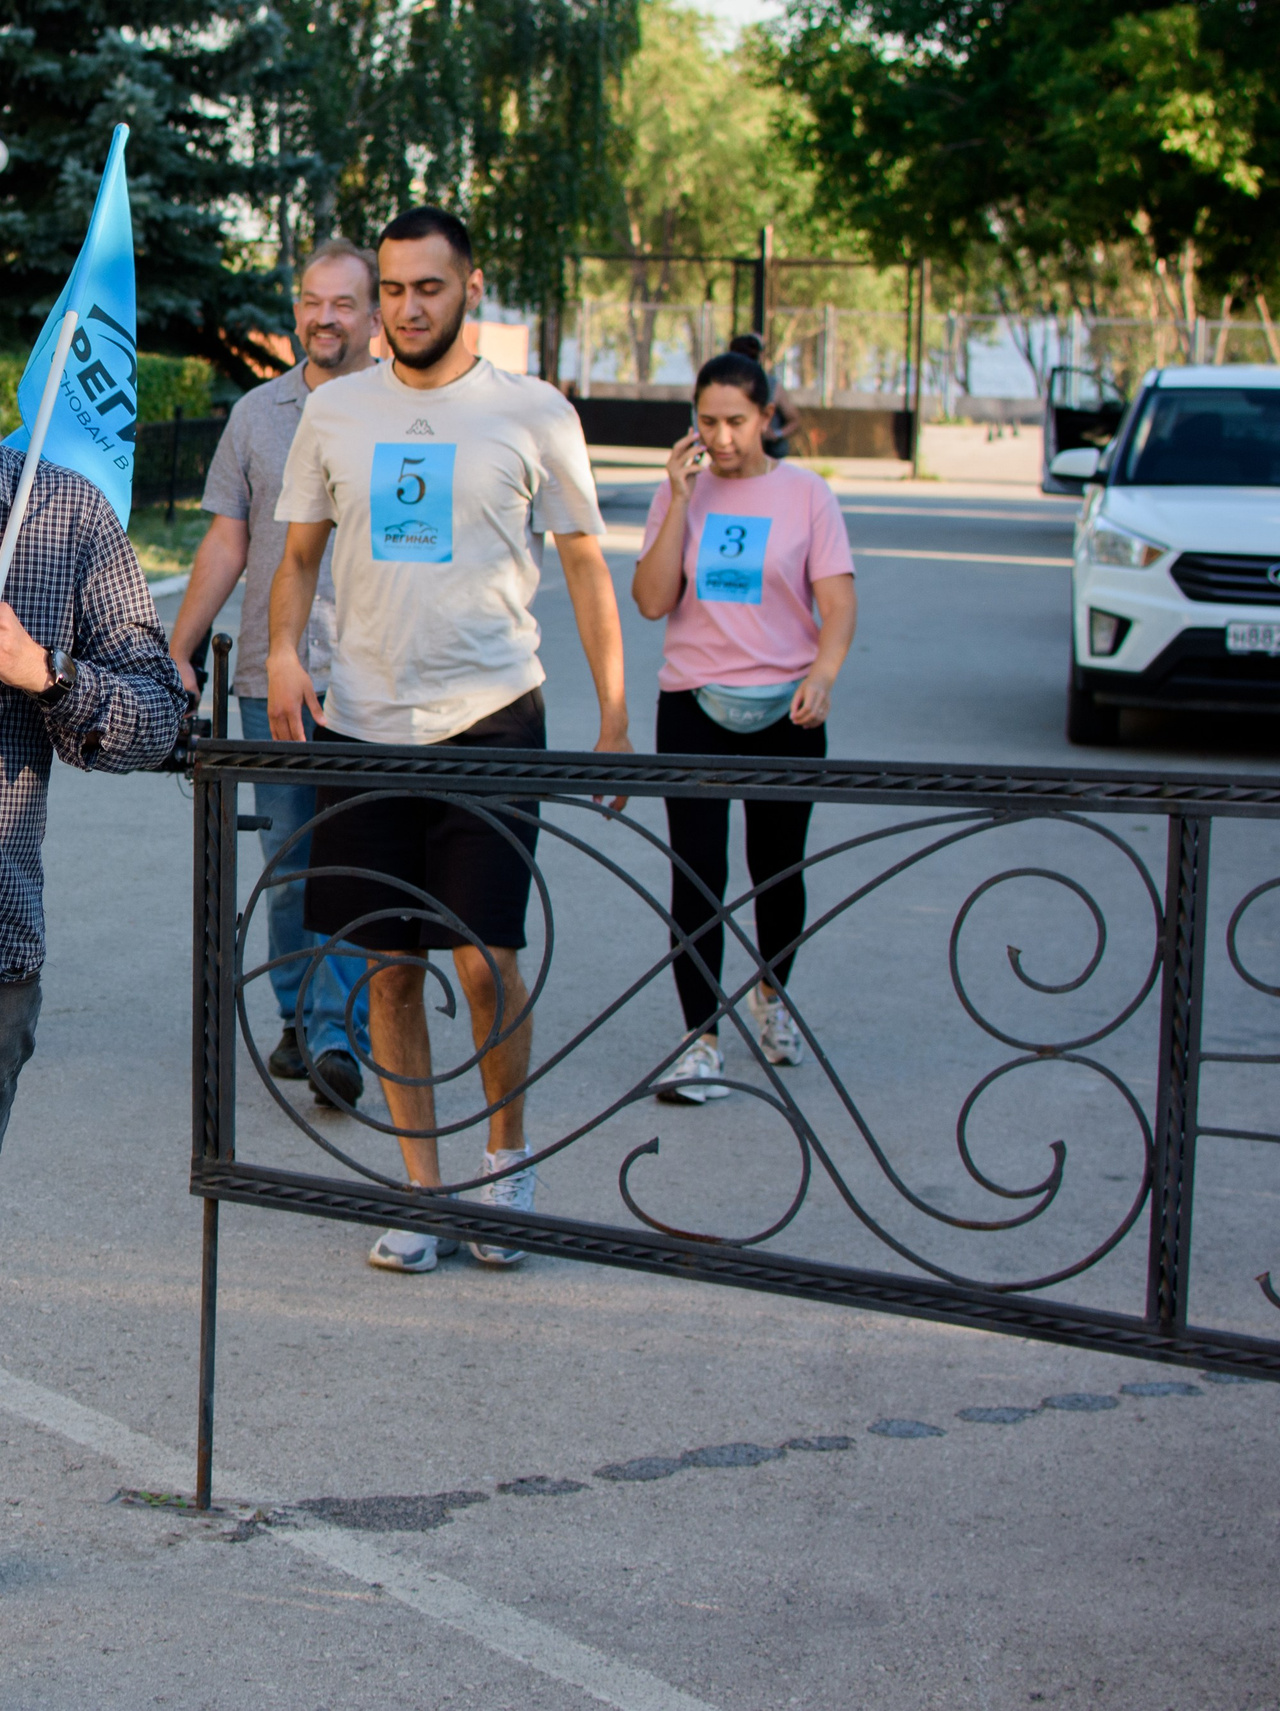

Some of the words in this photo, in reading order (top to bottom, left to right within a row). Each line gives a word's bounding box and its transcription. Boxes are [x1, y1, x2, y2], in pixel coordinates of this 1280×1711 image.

[51, 350, 115, 452] НОВАН
[113, 455, 129, 470] В
[396, 457, 426, 505] 5
[384, 533, 438, 545] РЕГИНАС
[719, 525, 747, 558] 3
